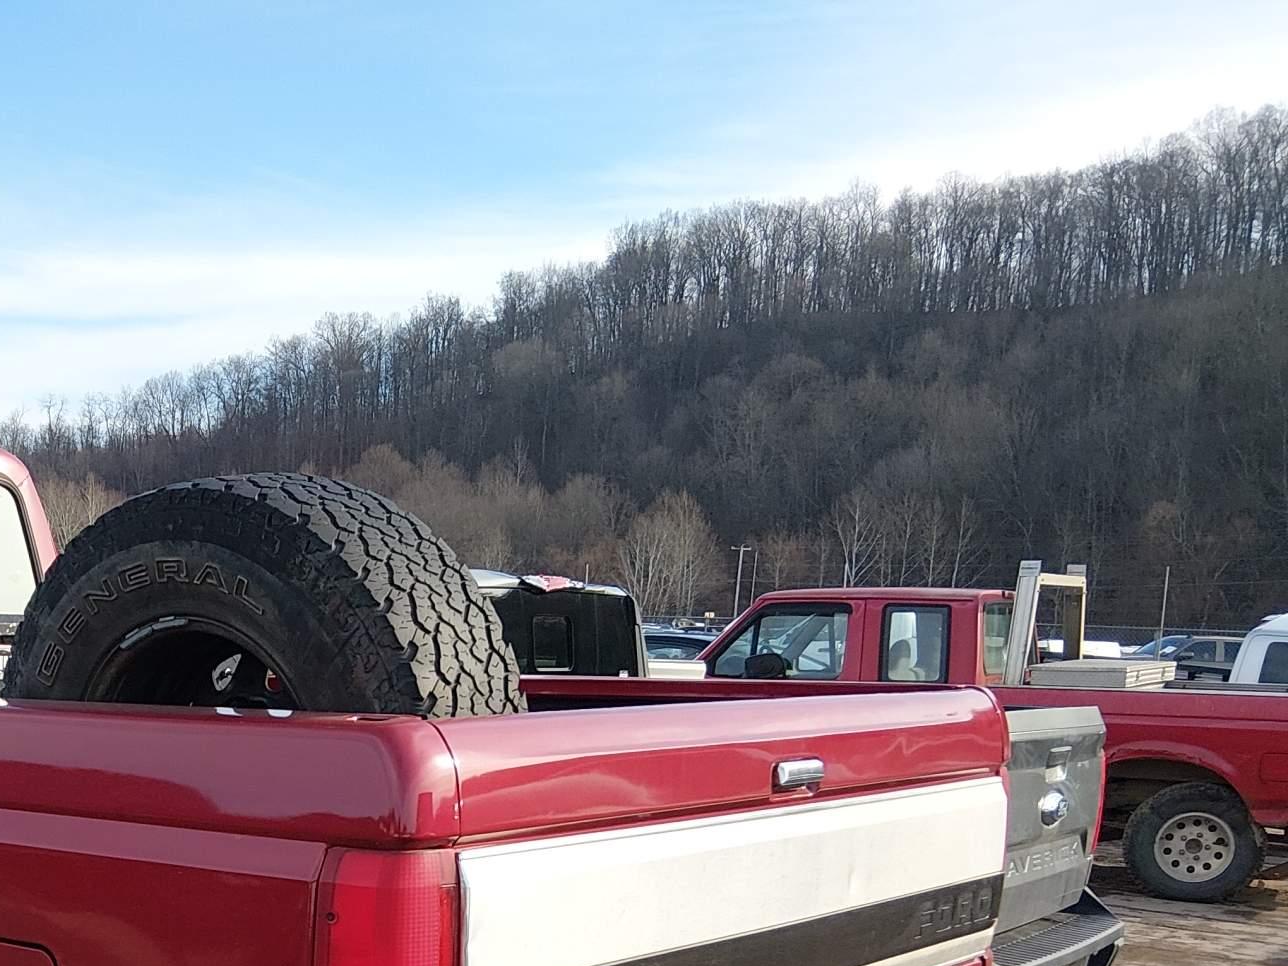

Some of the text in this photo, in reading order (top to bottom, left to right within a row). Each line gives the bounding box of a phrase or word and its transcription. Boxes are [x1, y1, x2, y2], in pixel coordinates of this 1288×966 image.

[35, 556, 265, 687] GENERAL
[1005, 841, 1079, 877] AVERICK
[912, 884, 994, 940] FORD
